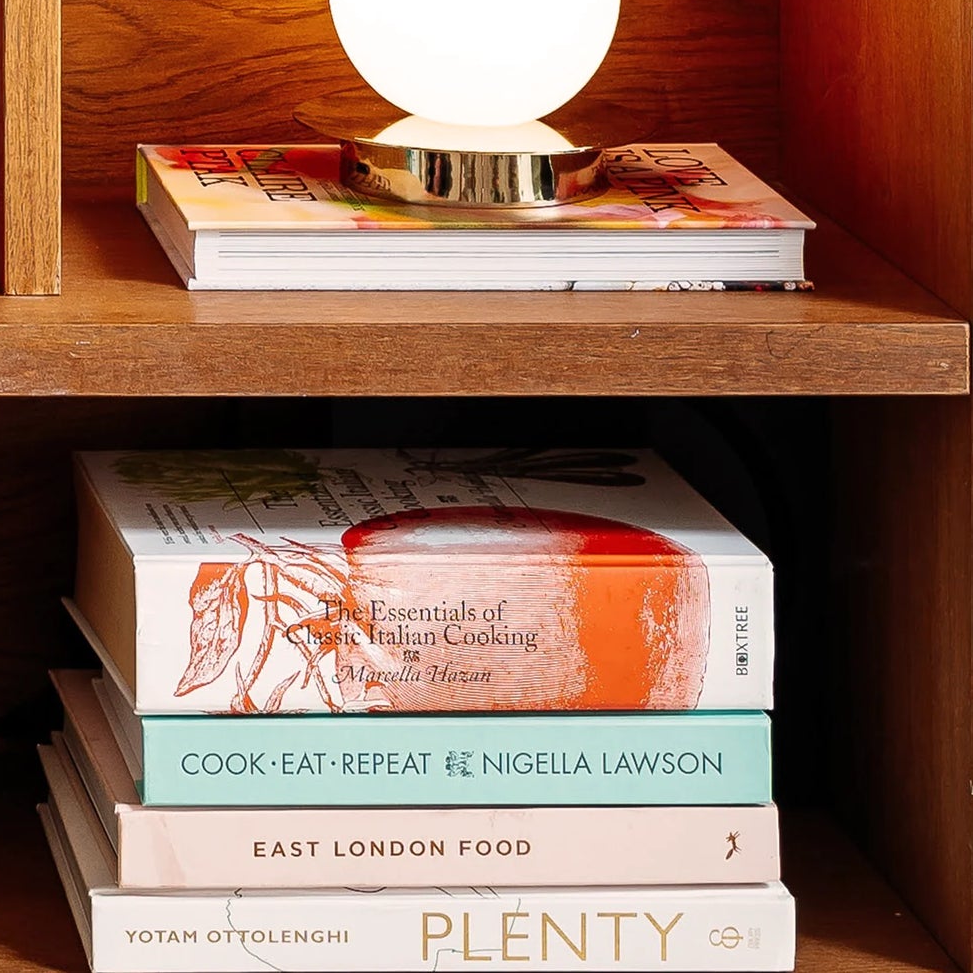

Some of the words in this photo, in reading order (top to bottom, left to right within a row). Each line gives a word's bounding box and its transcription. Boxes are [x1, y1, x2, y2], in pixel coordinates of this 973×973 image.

[180, 148, 249, 188] PTAK
[236, 149, 318, 203] CLAIRE
[643, 149, 728, 187] LOVE
[318, 599, 364, 622] The
[371, 600, 477, 622] Essentials
[482, 600, 507, 622] of
[286, 624, 361, 646] Classic
[368, 624, 436, 646] Italian
[444, 624, 539, 652] Cooking
[332, 664, 421, 684] Marcella
[426, 662, 492, 683] Hazan
[482, 751, 592, 775] NIGELLA
[602, 751, 723, 775] LAWSON
[253, 841, 320, 858] EAST
[334, 840, 445, 857] LONDON
[459, 839, 531, 857] FOOD
[125, 930, 197, 944] YOTAM
[206, 930, 349, 944] OTTOLENGHI
[421, 911, 684, 962] PLENTY
